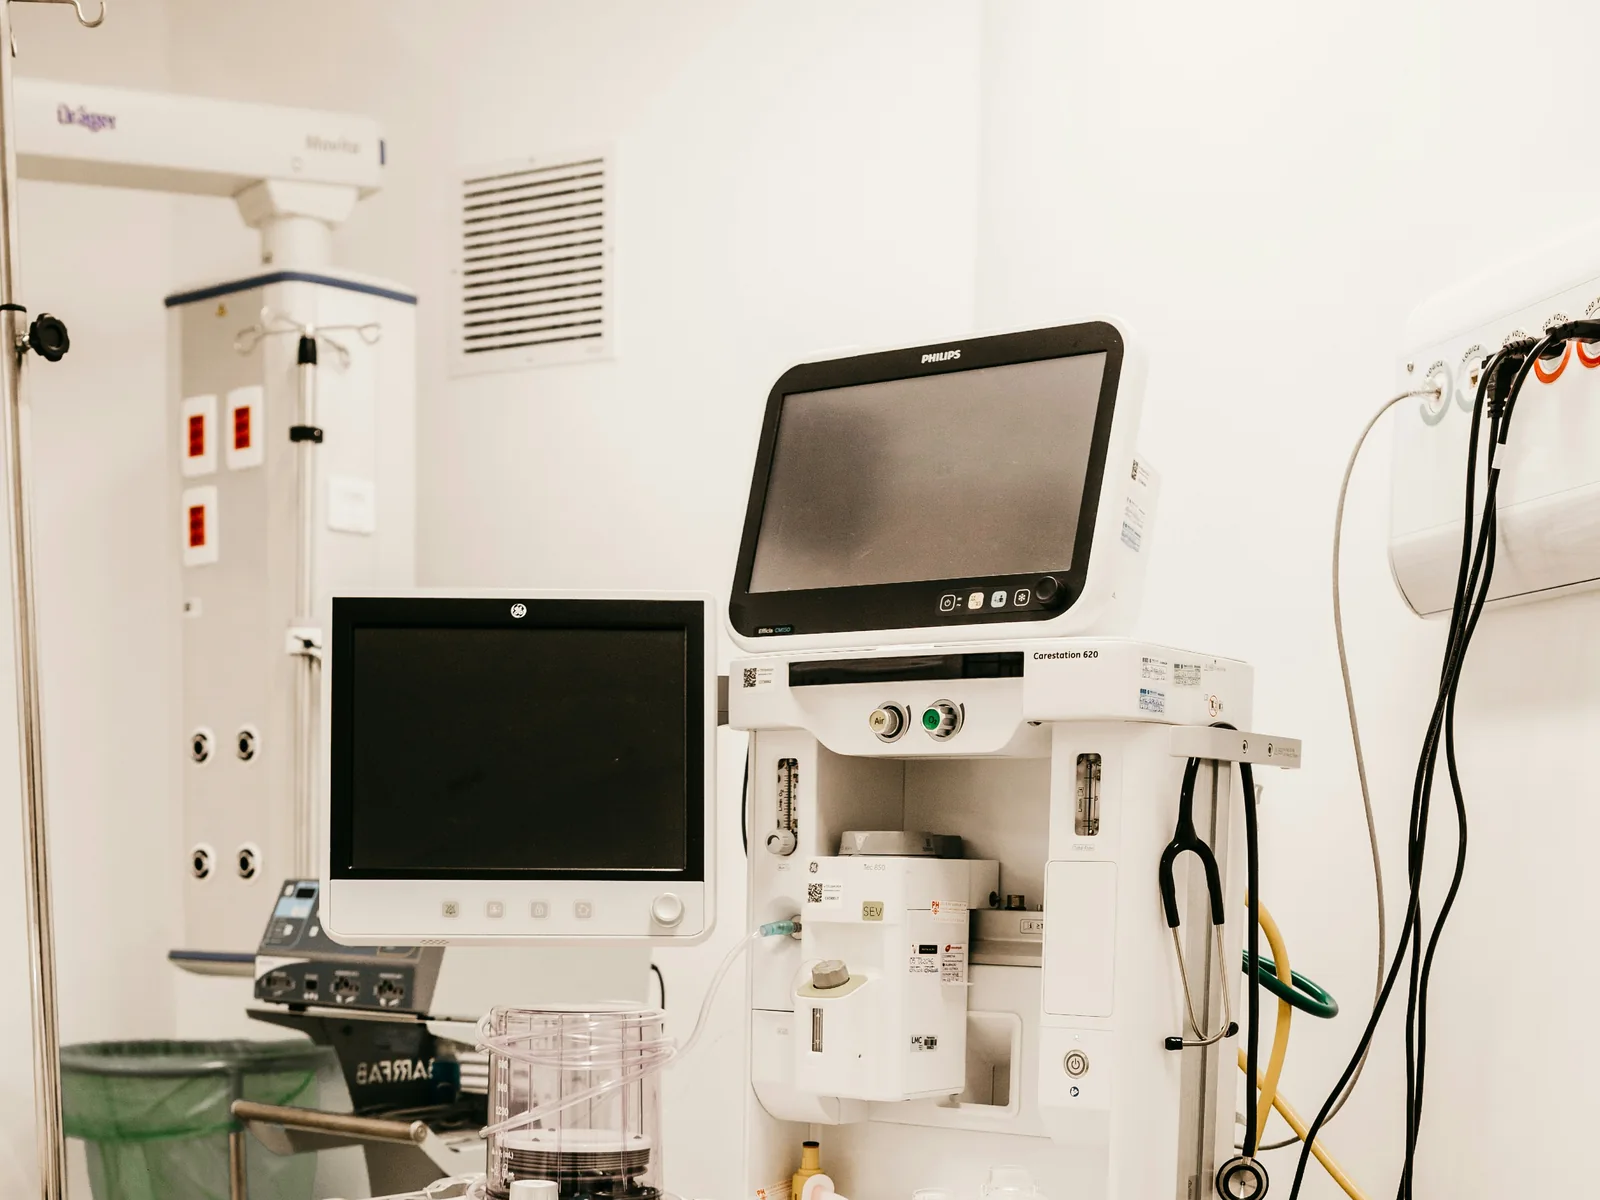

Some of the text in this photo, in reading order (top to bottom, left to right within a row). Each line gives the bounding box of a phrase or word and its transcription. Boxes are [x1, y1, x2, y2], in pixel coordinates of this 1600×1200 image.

[921, 349, 961, 364] PHILIPS
[1033, 650, 1099, 660] Carestation 620
[874, 717, 885, 725] Air
[932, 901, 940, 909] PH
[863, 906, 882, 917] SEV
[911, 1036, 922, 1044] LMC
